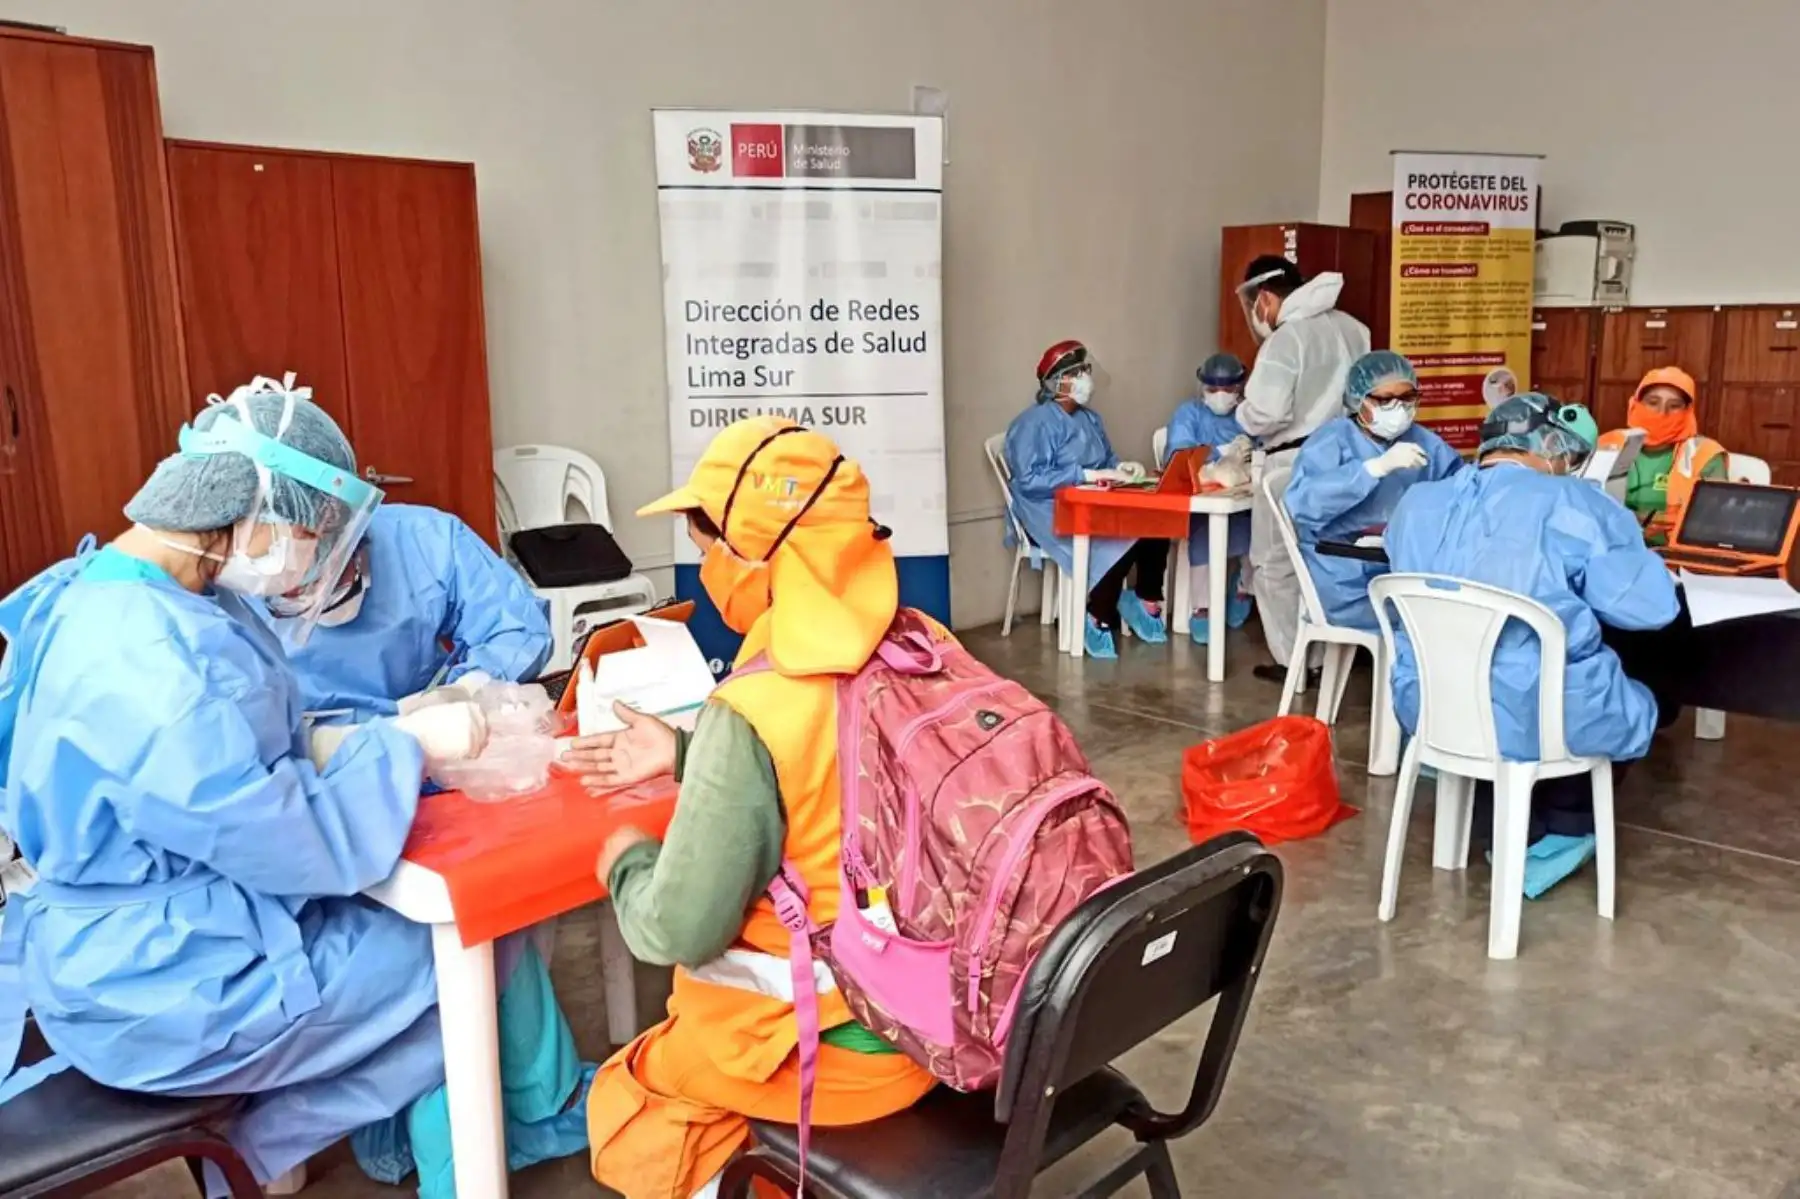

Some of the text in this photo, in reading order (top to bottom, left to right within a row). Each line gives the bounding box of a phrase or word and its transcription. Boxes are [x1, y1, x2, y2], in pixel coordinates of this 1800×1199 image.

[739, 141, 778, 158] PERÚ
[794, 144, 850, 156] Ministerio
[793, 158, 842, 170] de Salud
[1408, 171, 1527, 191] PROTÉGETE DEL
[1405, 194, 1528, 211] CORONAVIRUS
[685, 298, 920, 322] Dirección de Redes
[686, 330, 927, 359] Integradas de Salud
[687, 364, 795, 387] Lima Sur
[690, 406, 867, 427] DIRIS MA SUR
